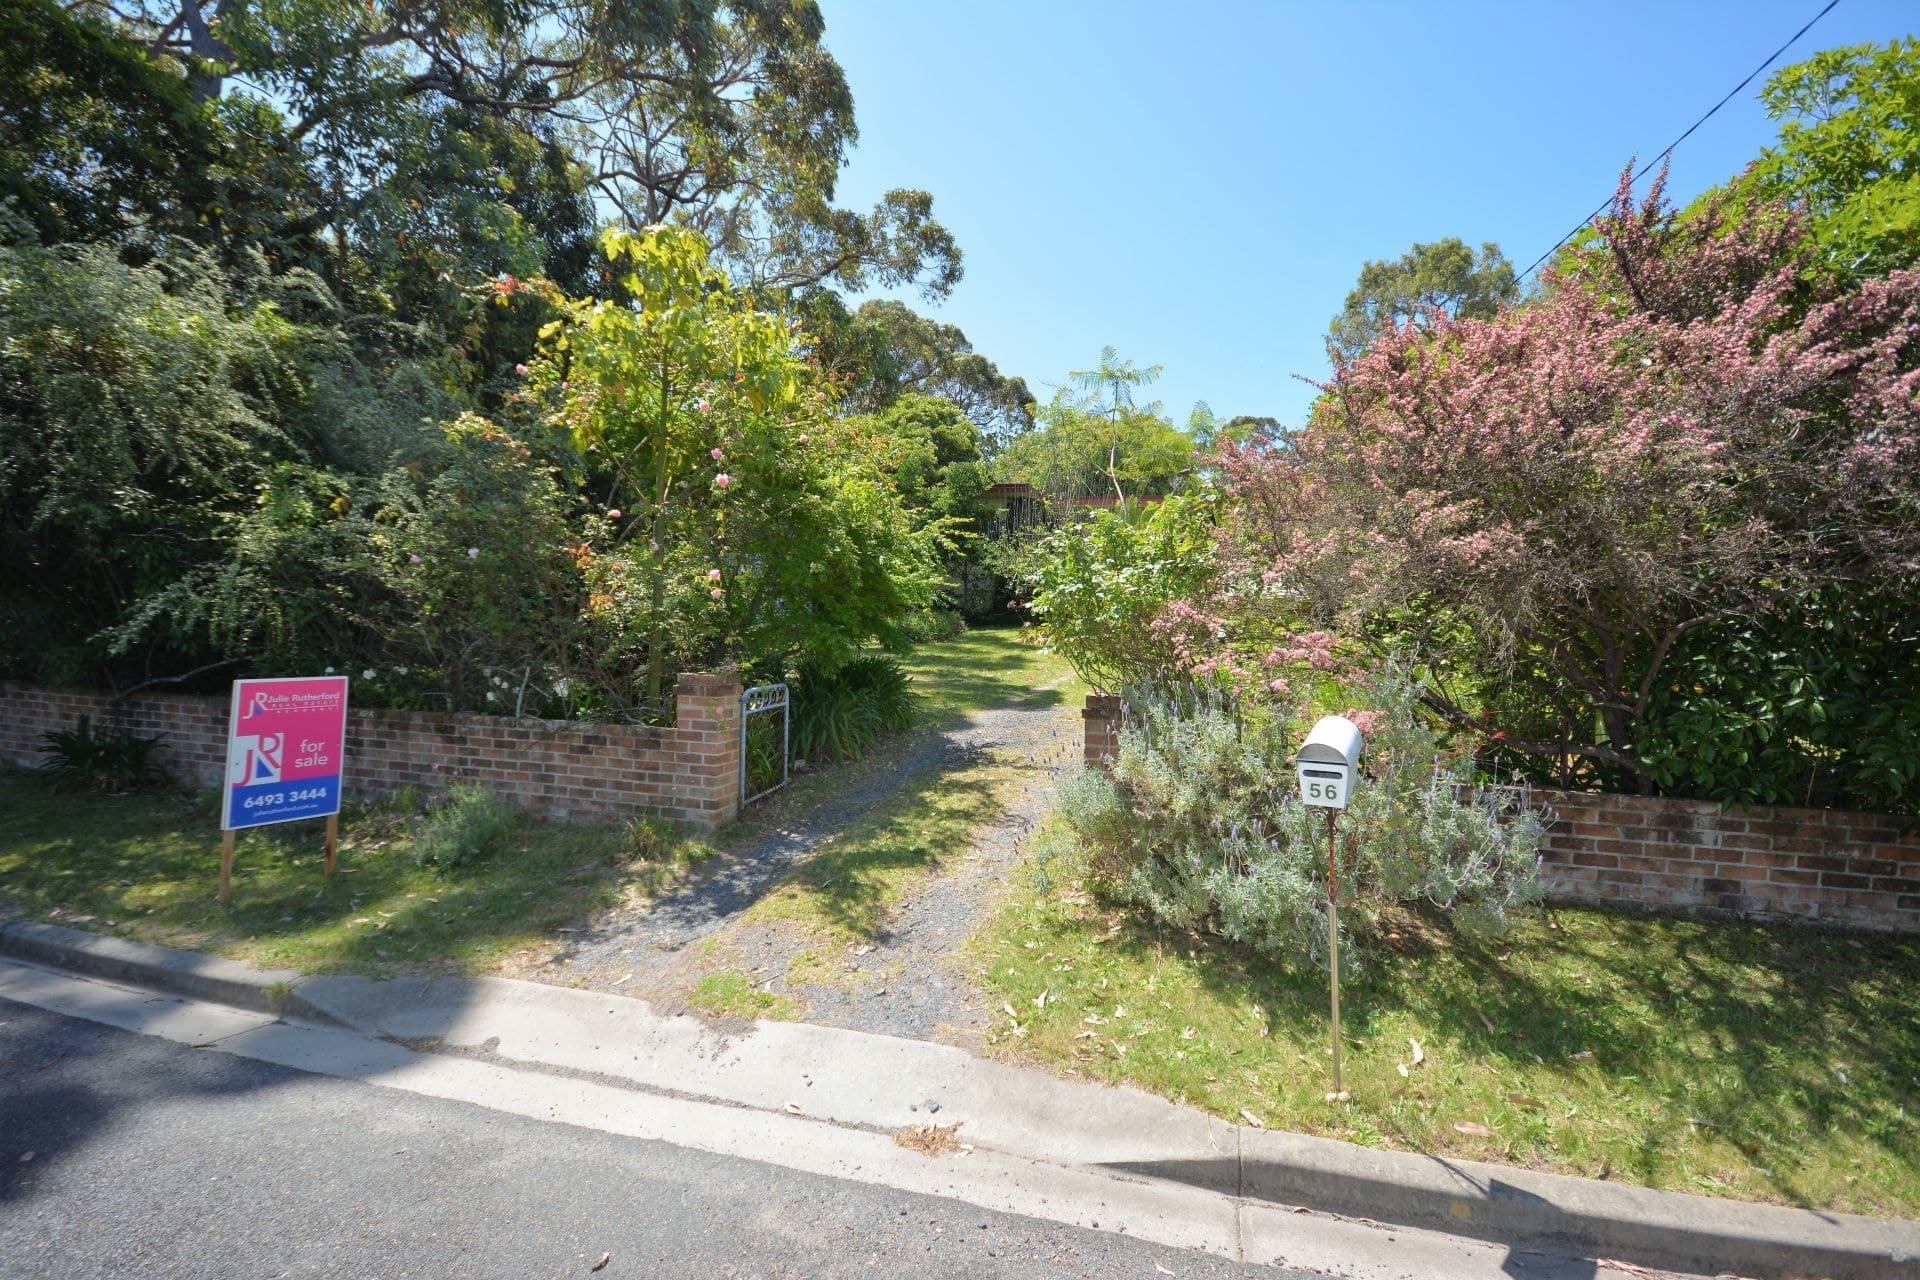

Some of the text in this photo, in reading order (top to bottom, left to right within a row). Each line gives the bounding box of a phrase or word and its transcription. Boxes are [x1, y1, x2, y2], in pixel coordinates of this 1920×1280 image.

[267, 691, 340, 703] Julie Rutherford
[299, 739, 326, 753] for
[294, 753, 328, 768] sale
[243, 787, 327, 809] 6493 3444
[1310, 783, 1337, 800] 56
